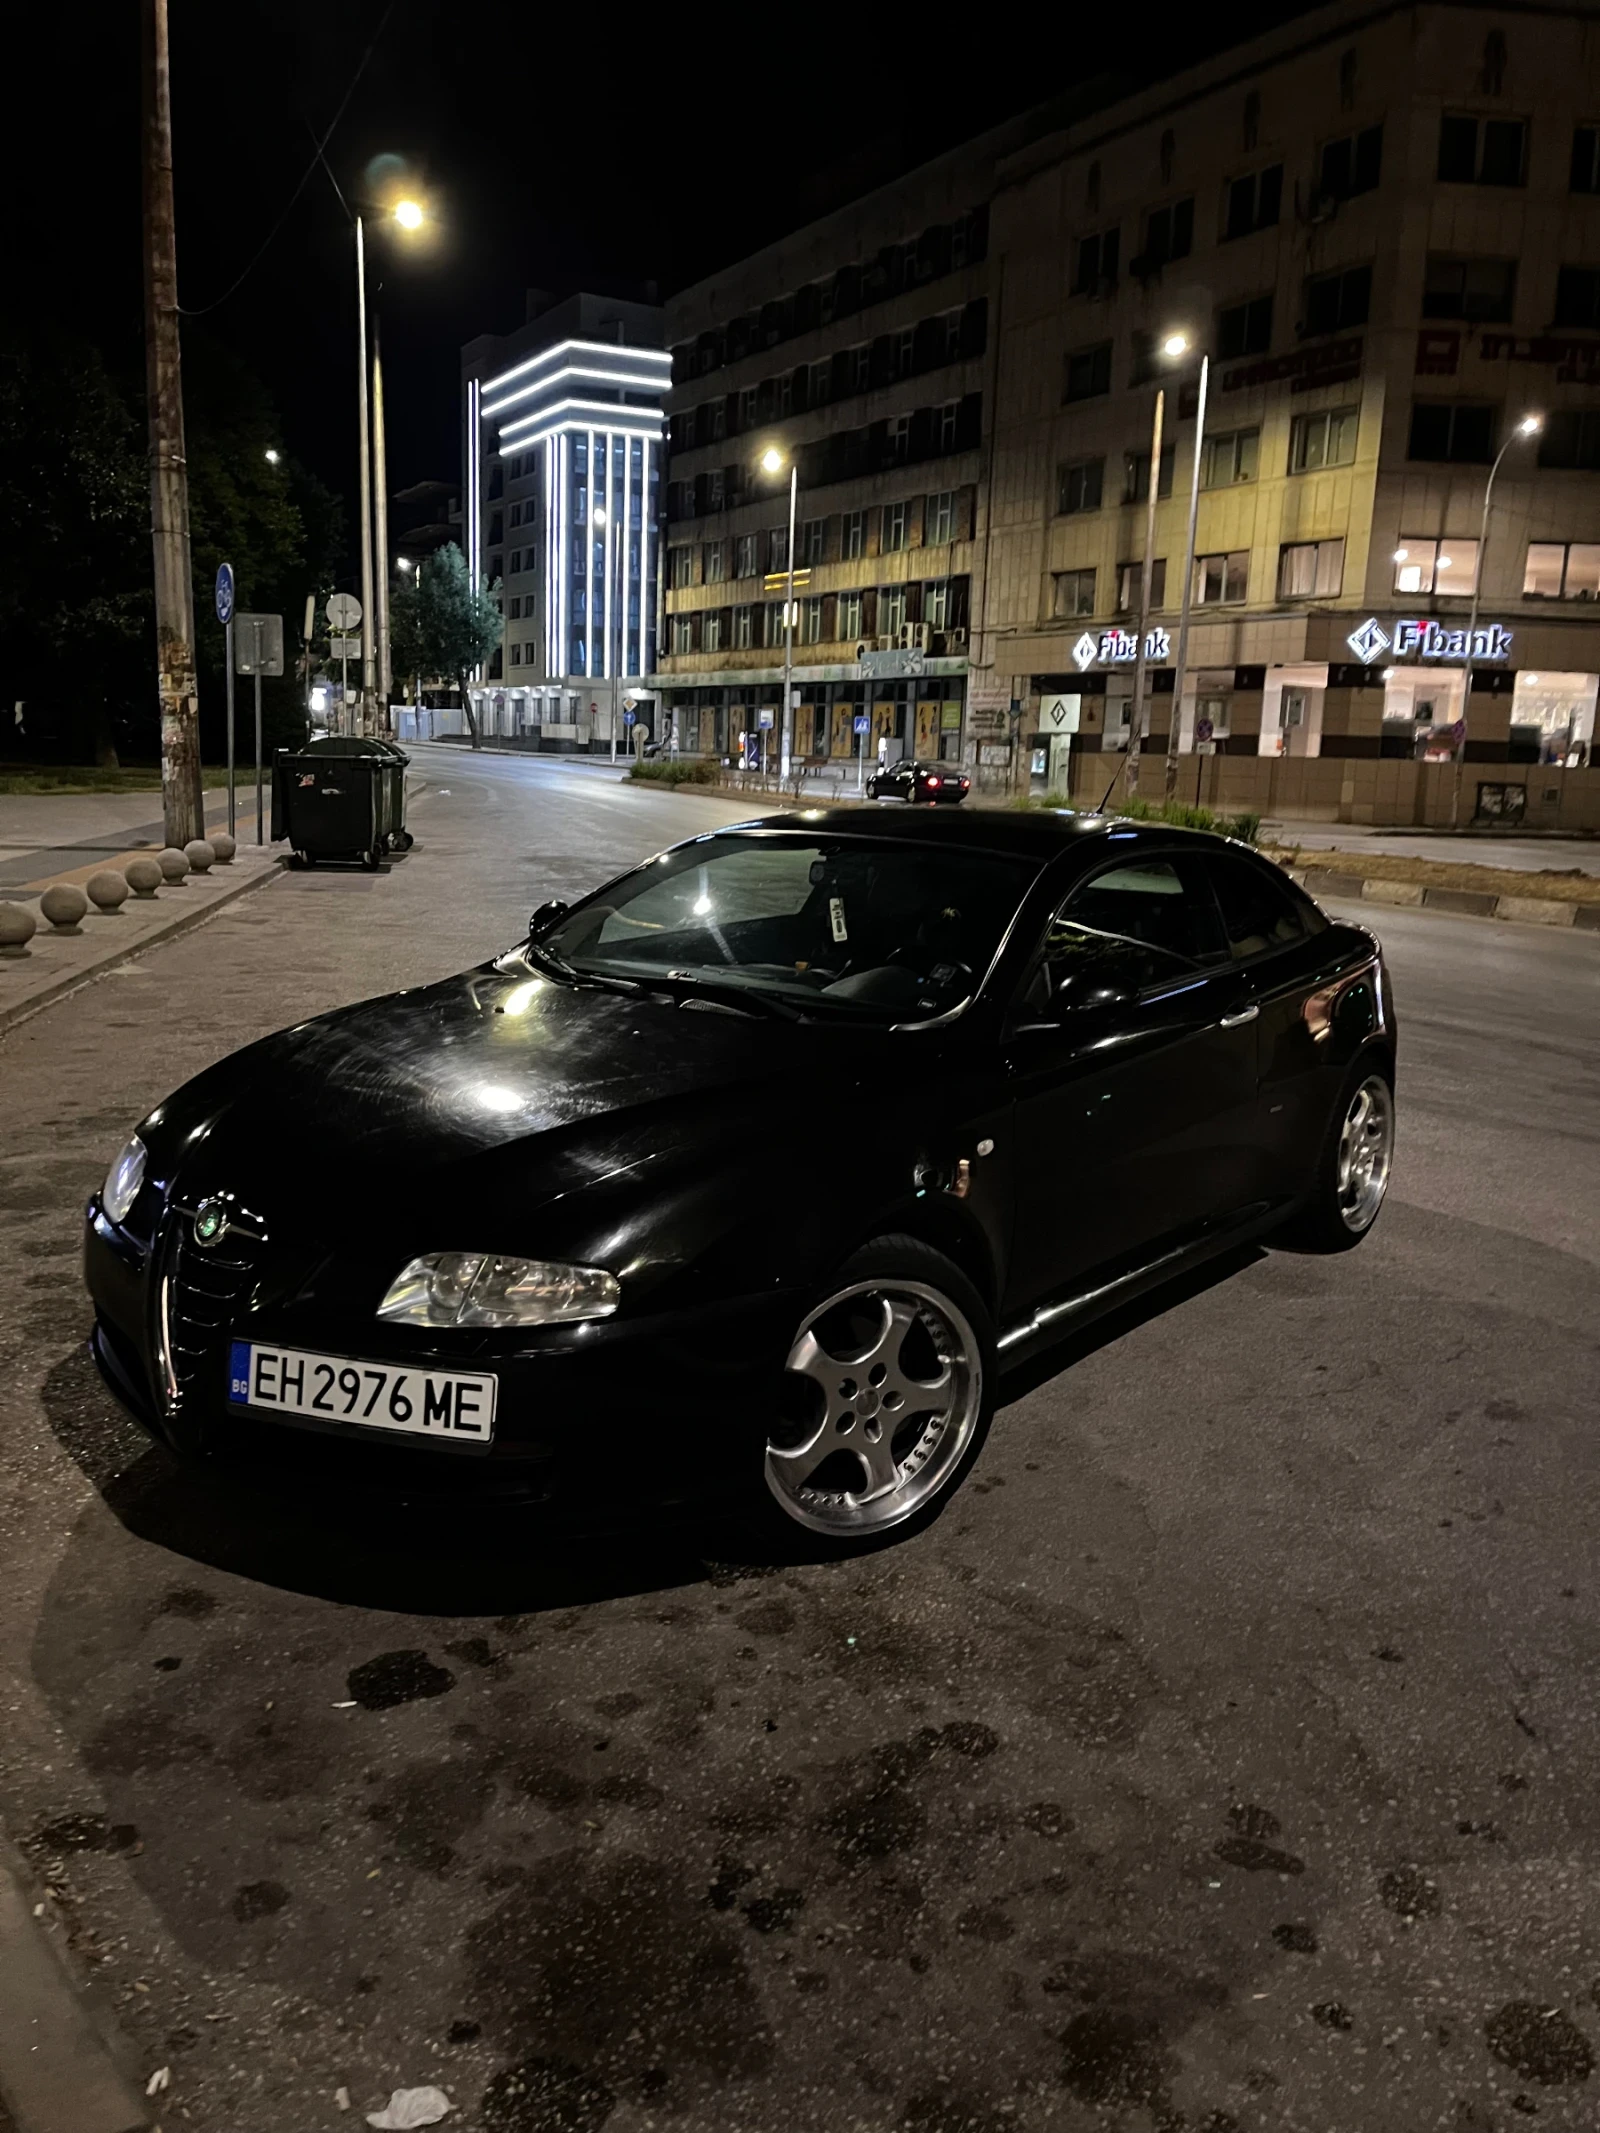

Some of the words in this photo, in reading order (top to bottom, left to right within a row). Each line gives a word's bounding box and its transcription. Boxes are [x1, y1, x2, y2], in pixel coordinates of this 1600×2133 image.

[1394, 620, 1512, 658] Fibank
[231, 1379, 248, 1394] BG
[254, 1353, 304, 1406] EH
[312, 1364, 413, 1422] 2976
[423, 1378, 483, 1432] ME
